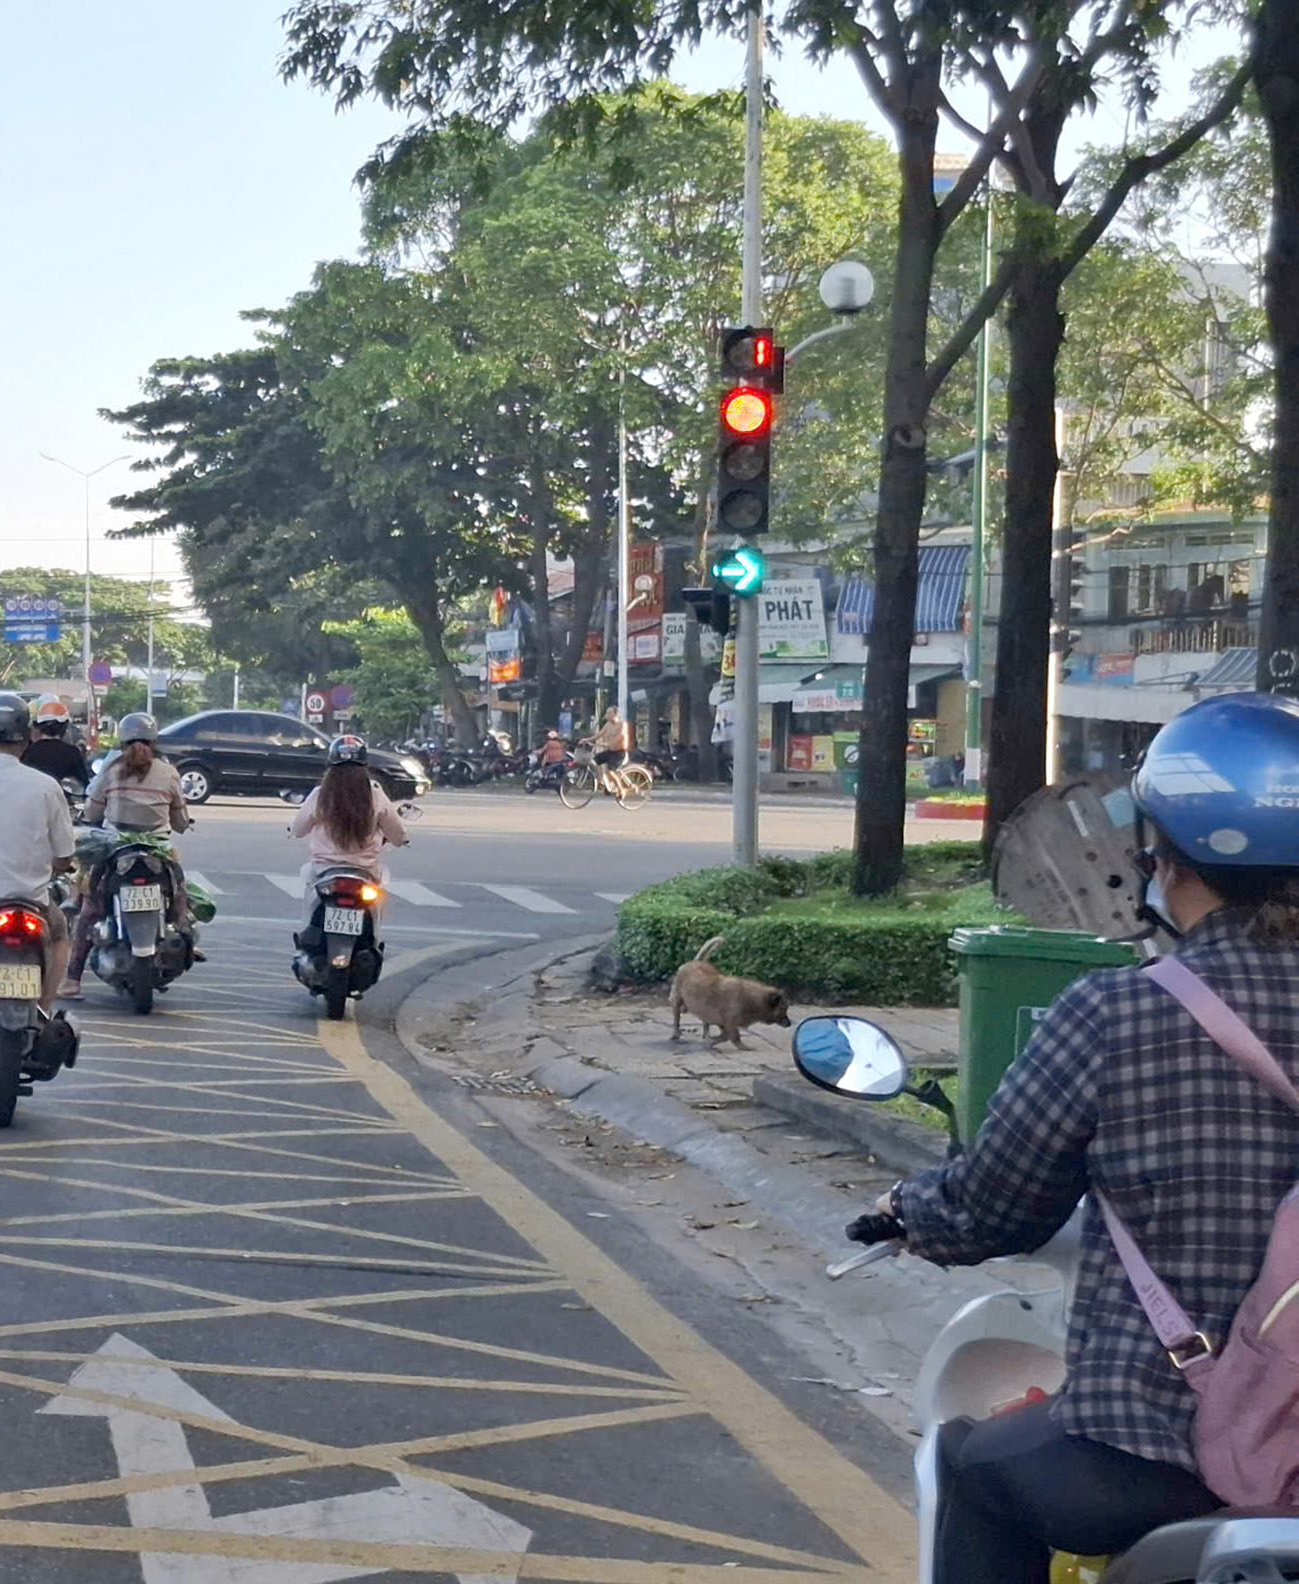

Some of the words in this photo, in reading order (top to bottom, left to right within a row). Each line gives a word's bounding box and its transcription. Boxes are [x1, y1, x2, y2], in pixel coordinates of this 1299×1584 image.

[764, 596, 813, 621] PHÁT
[666, 624, 684, 635] GIA
[310, 698, 321, 709] 50
